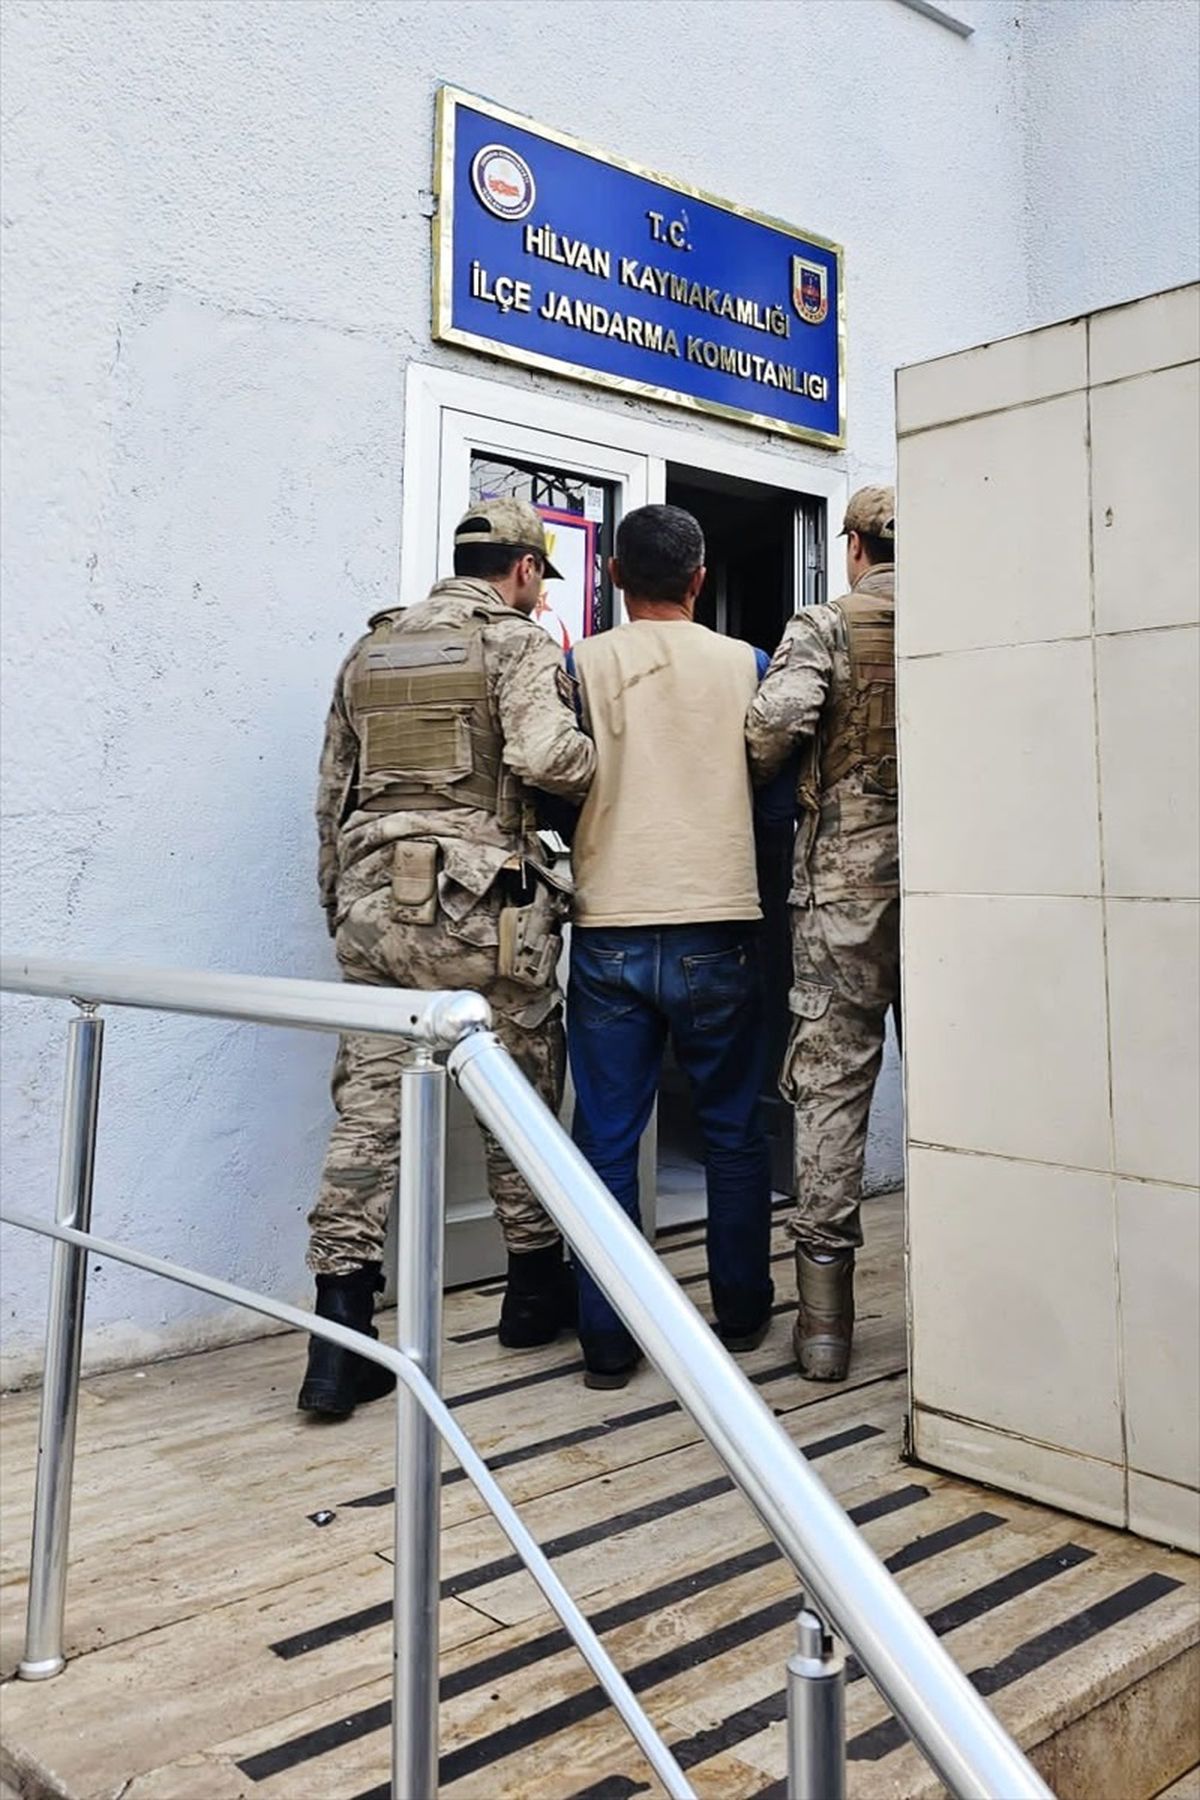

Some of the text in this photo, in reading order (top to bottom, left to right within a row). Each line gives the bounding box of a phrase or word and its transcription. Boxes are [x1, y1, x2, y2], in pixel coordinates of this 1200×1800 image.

[649, 211, 692, 250] T.C.
[472, 260, 532, 313] İLÇE
[541, 291, 680, 357] JANDARMA
[525, 223, 790, 337] HİLVAN KAYMAKAMLIĞI
